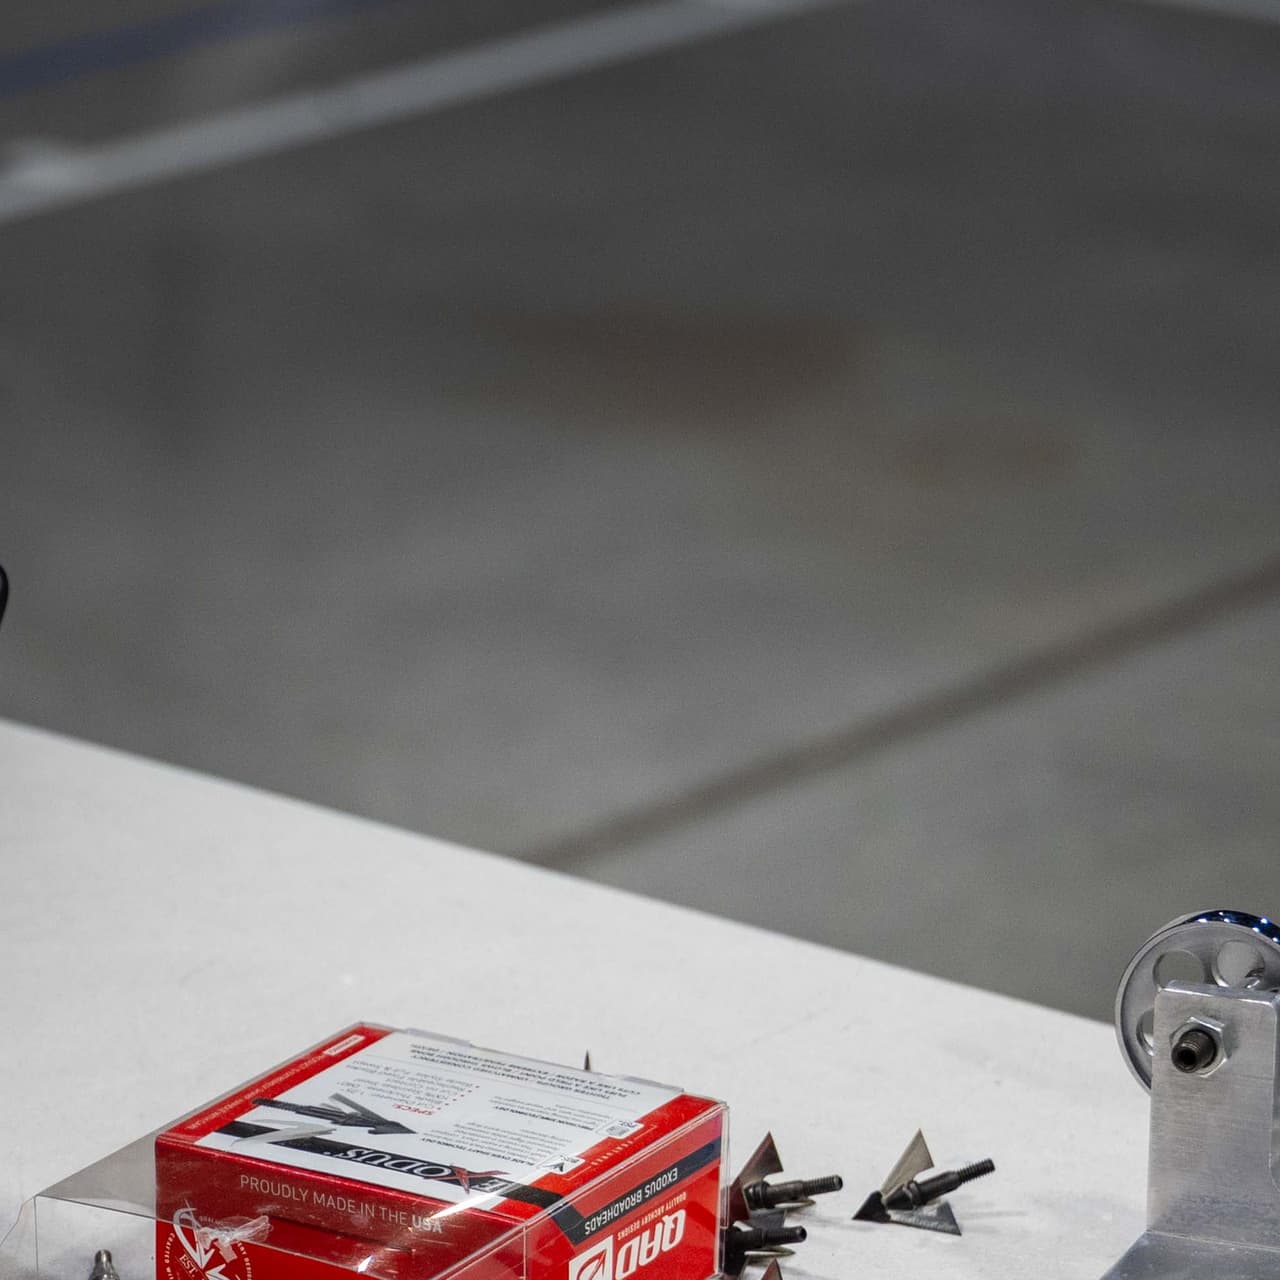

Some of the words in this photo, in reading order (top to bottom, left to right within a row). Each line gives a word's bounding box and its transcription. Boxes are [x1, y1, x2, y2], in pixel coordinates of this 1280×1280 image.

[388, 1102, 437, 1116] SPECS:
[418, 1137, 468, 1150] TECHNOLOGY
[340, 1144, 510, 1195] EXODUS
[644, 1168, 678, 1195] EXODUS
[240, 1174, 308, 1202] PROUDLY
[314, 1190, 355, 1214] MADE
[360, 1201, 376, 1218] IN
[378, 1207, 407, 1226] THE
[412, 1214, 444, 1234] USA
[584, 1189, 642, 1235] BROADHEADS
[640, 1203, 665, 1225] ARCHERY
[665, 1191, 687, 1213] QUALITY
[617, 1216, 640, 1240] DESIGNS
[164, 1232, 175, 1265] CRAFTED
[615, 1209, 686, 1280] QAD
[179, 1253, 199, 1278] EST.
